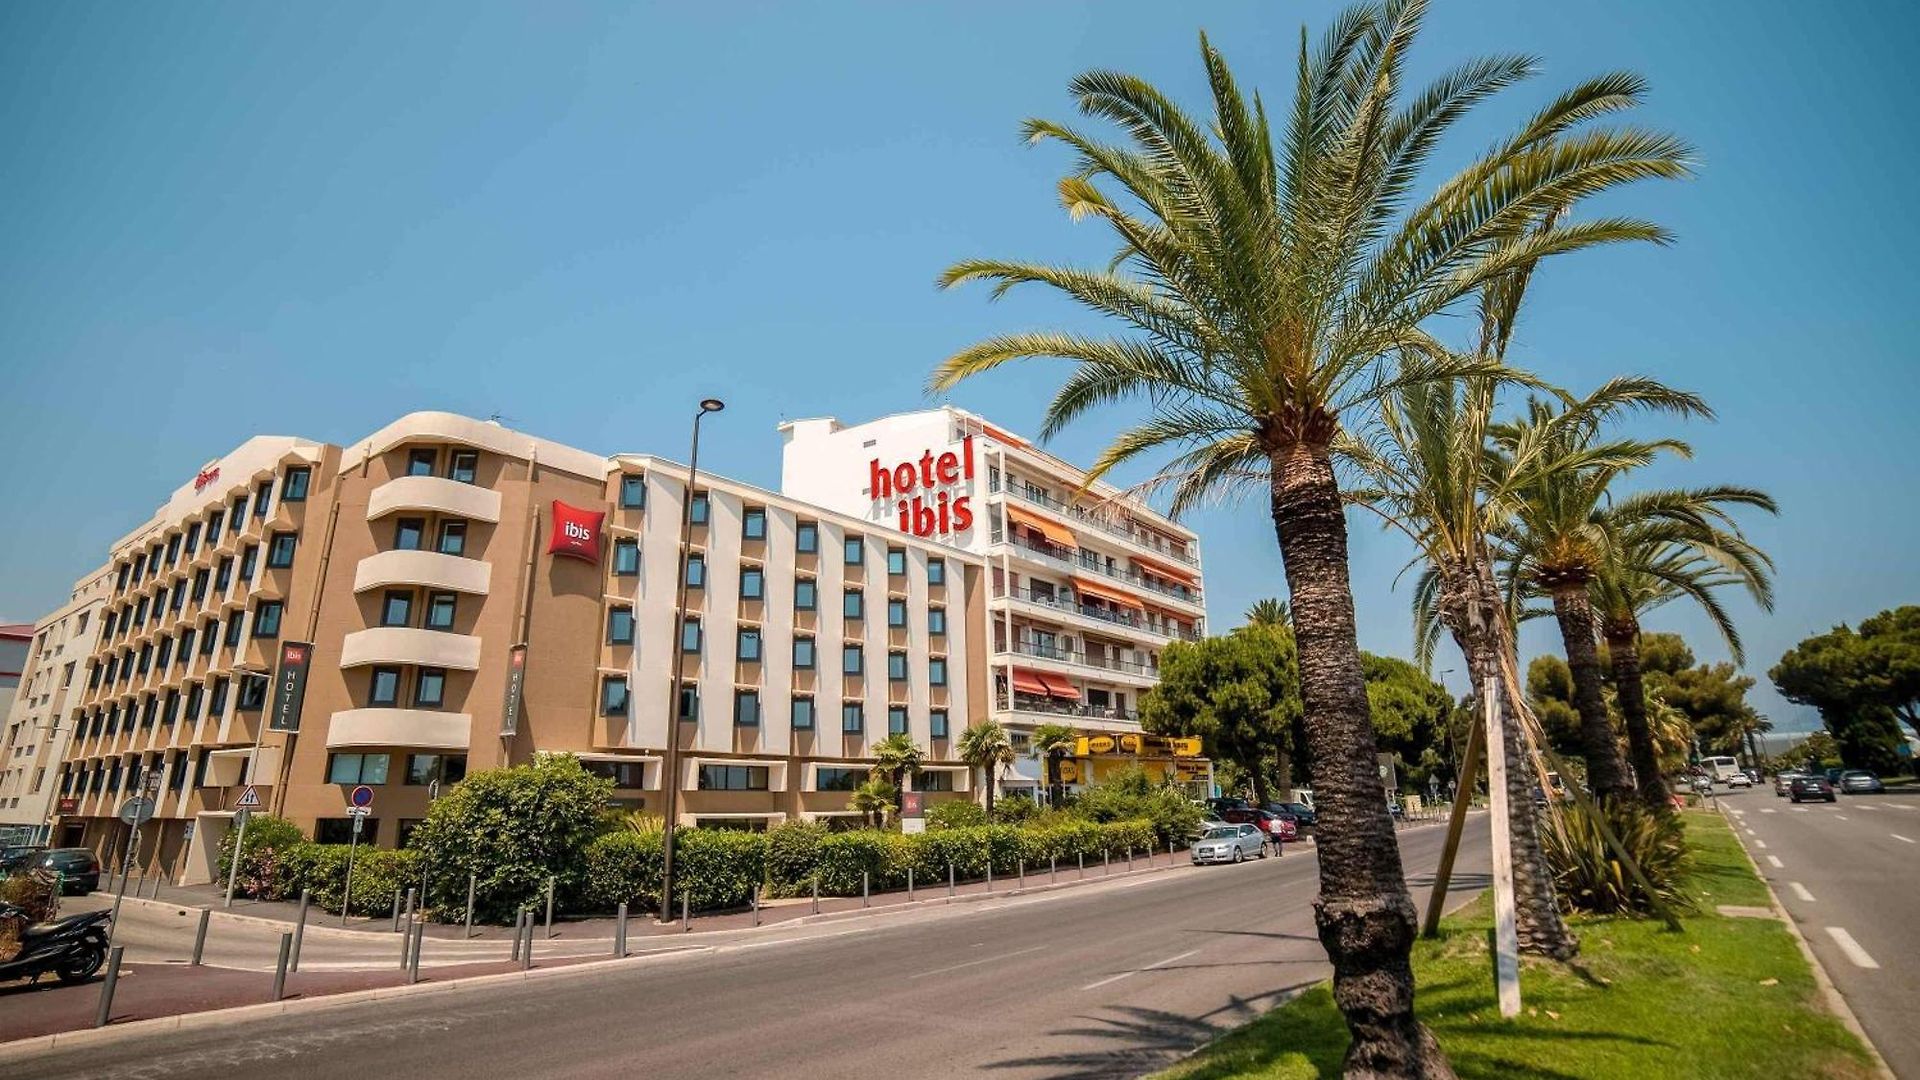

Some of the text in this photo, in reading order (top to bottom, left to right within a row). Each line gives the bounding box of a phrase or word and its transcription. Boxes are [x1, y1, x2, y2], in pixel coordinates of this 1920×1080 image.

[870, 434, 974, 501] hotel
[564, 521, 591, 541] ibis
[898, 491, 973, 537] ibis
[281, 671, 296, 725] HOTEL
